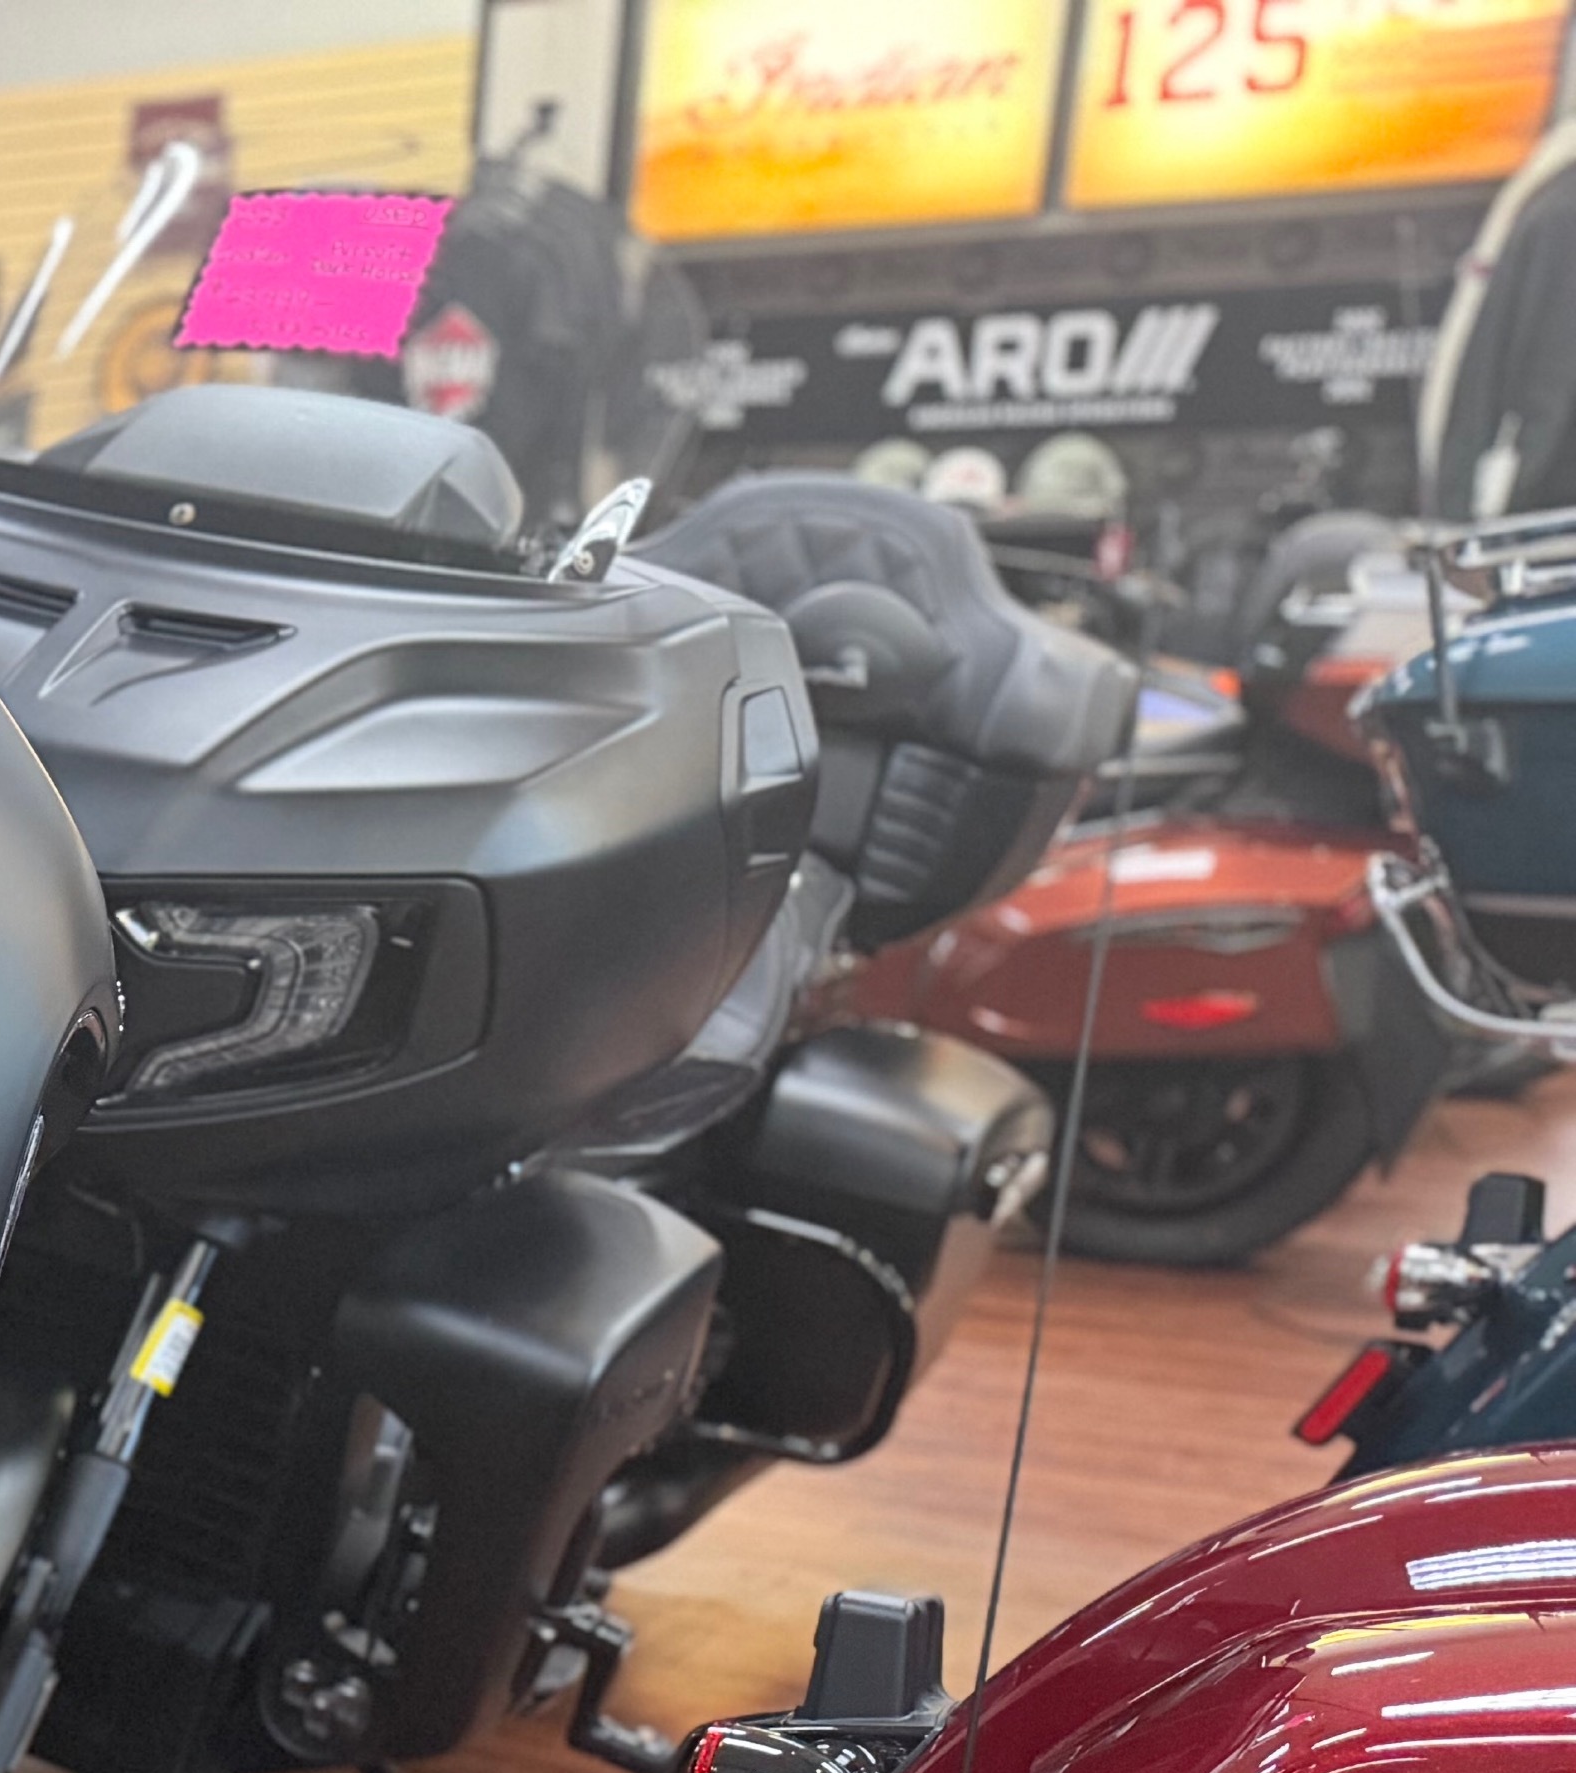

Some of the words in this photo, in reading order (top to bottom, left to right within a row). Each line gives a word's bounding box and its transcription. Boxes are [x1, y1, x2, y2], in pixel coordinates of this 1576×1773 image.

[1104, 0, 1307, 109] 125
[362, 207, 428, 225] USED
[331, 240, 413, 260] Pursuit
